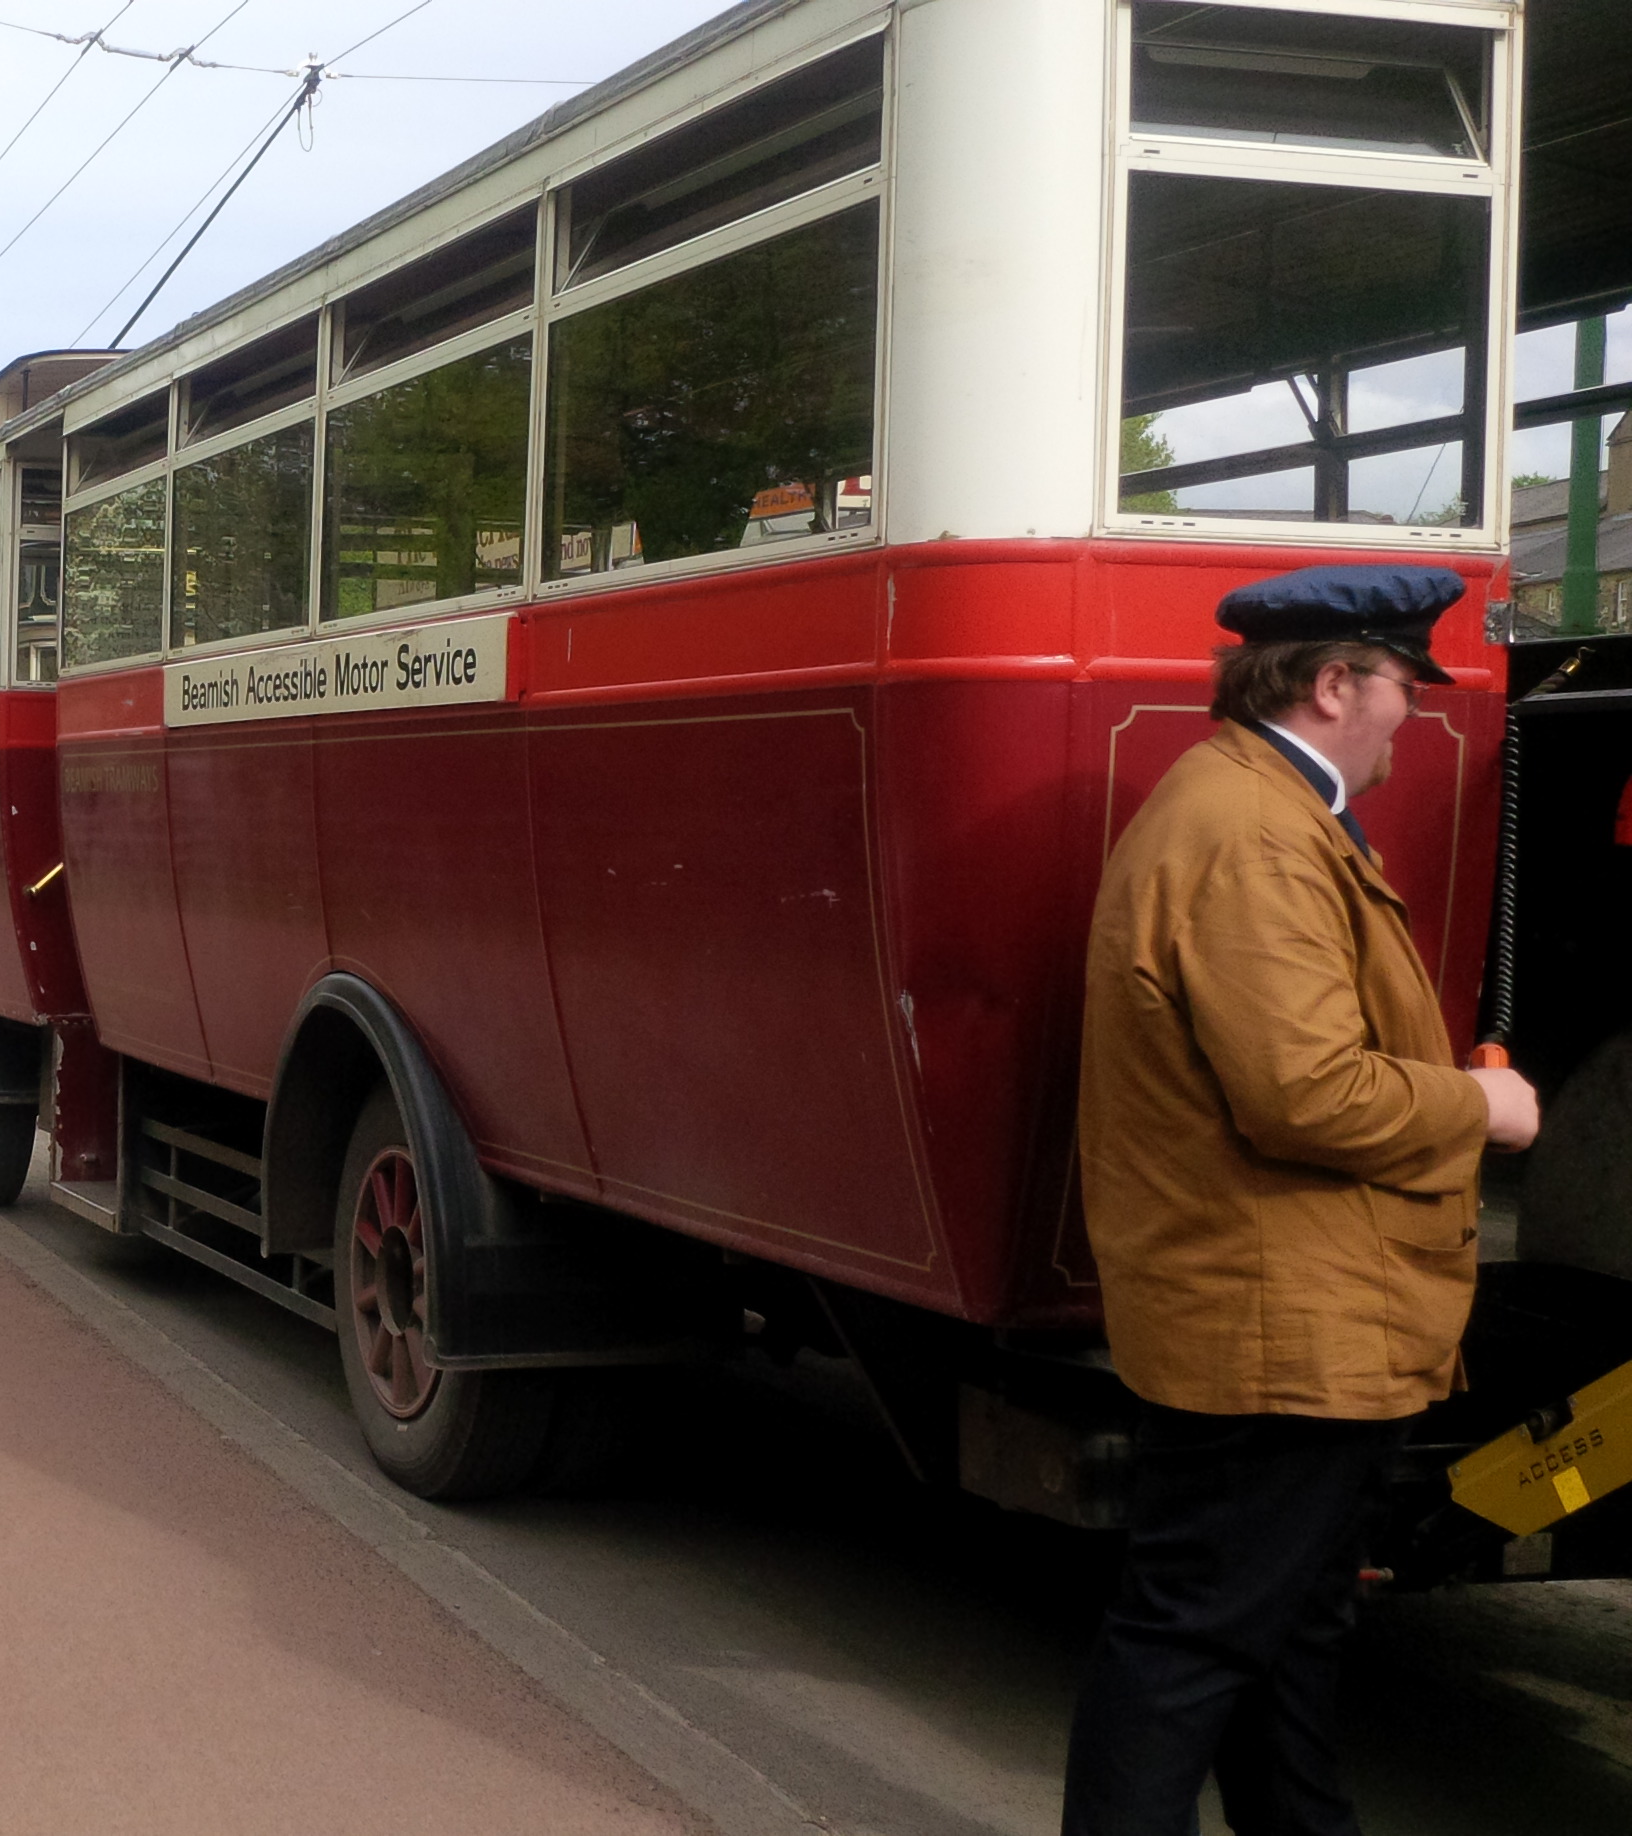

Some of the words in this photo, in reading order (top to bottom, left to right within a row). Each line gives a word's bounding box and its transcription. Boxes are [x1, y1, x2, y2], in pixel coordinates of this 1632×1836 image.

[182, 669, 239, 711] Beamish
[245, 657, 327, 705] Accessible
[334, 652, 389, 696] Motor
[396, 638, 477, 690] Service
[64, 767, 102, 792] BEAMISH
[104, 765, 159, 792] TRAMWAYS
[1520, 1429, 1603, 1487] ACCESS
